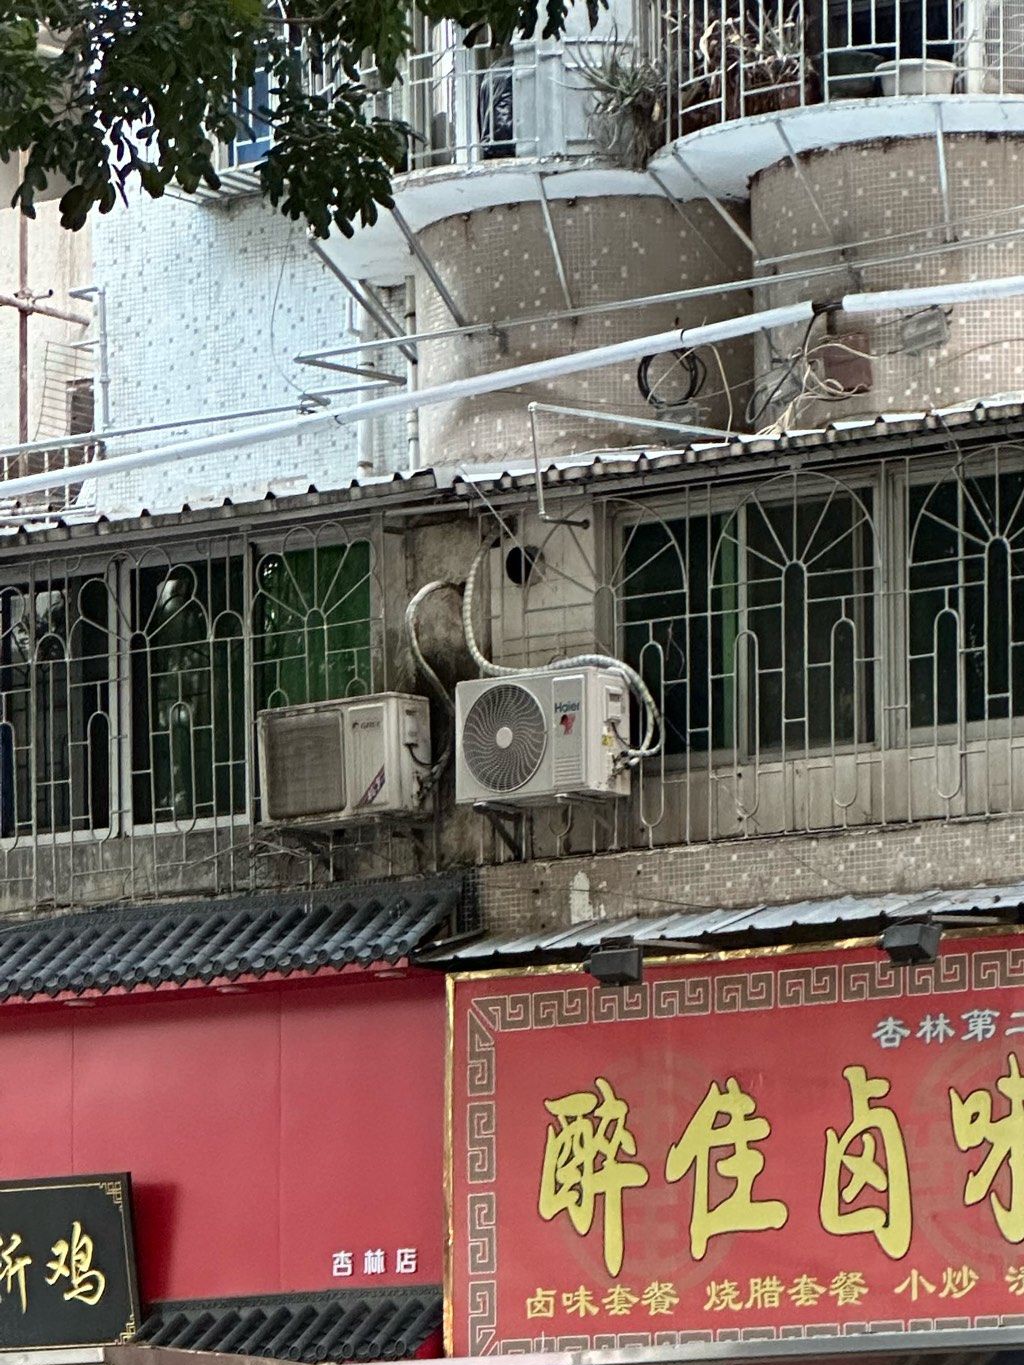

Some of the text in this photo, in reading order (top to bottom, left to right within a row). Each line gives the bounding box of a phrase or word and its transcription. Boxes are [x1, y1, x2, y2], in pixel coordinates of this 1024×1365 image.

[554, 701, 580, 713] Haier
[332, 1248, 417, 1277] 杏林店
[525, 1280, 680, 1319] 卤味套餐
[705, 1270, 869, 1311] 烧腊套餐
[894, 1265, 979, 1301] 小炒
